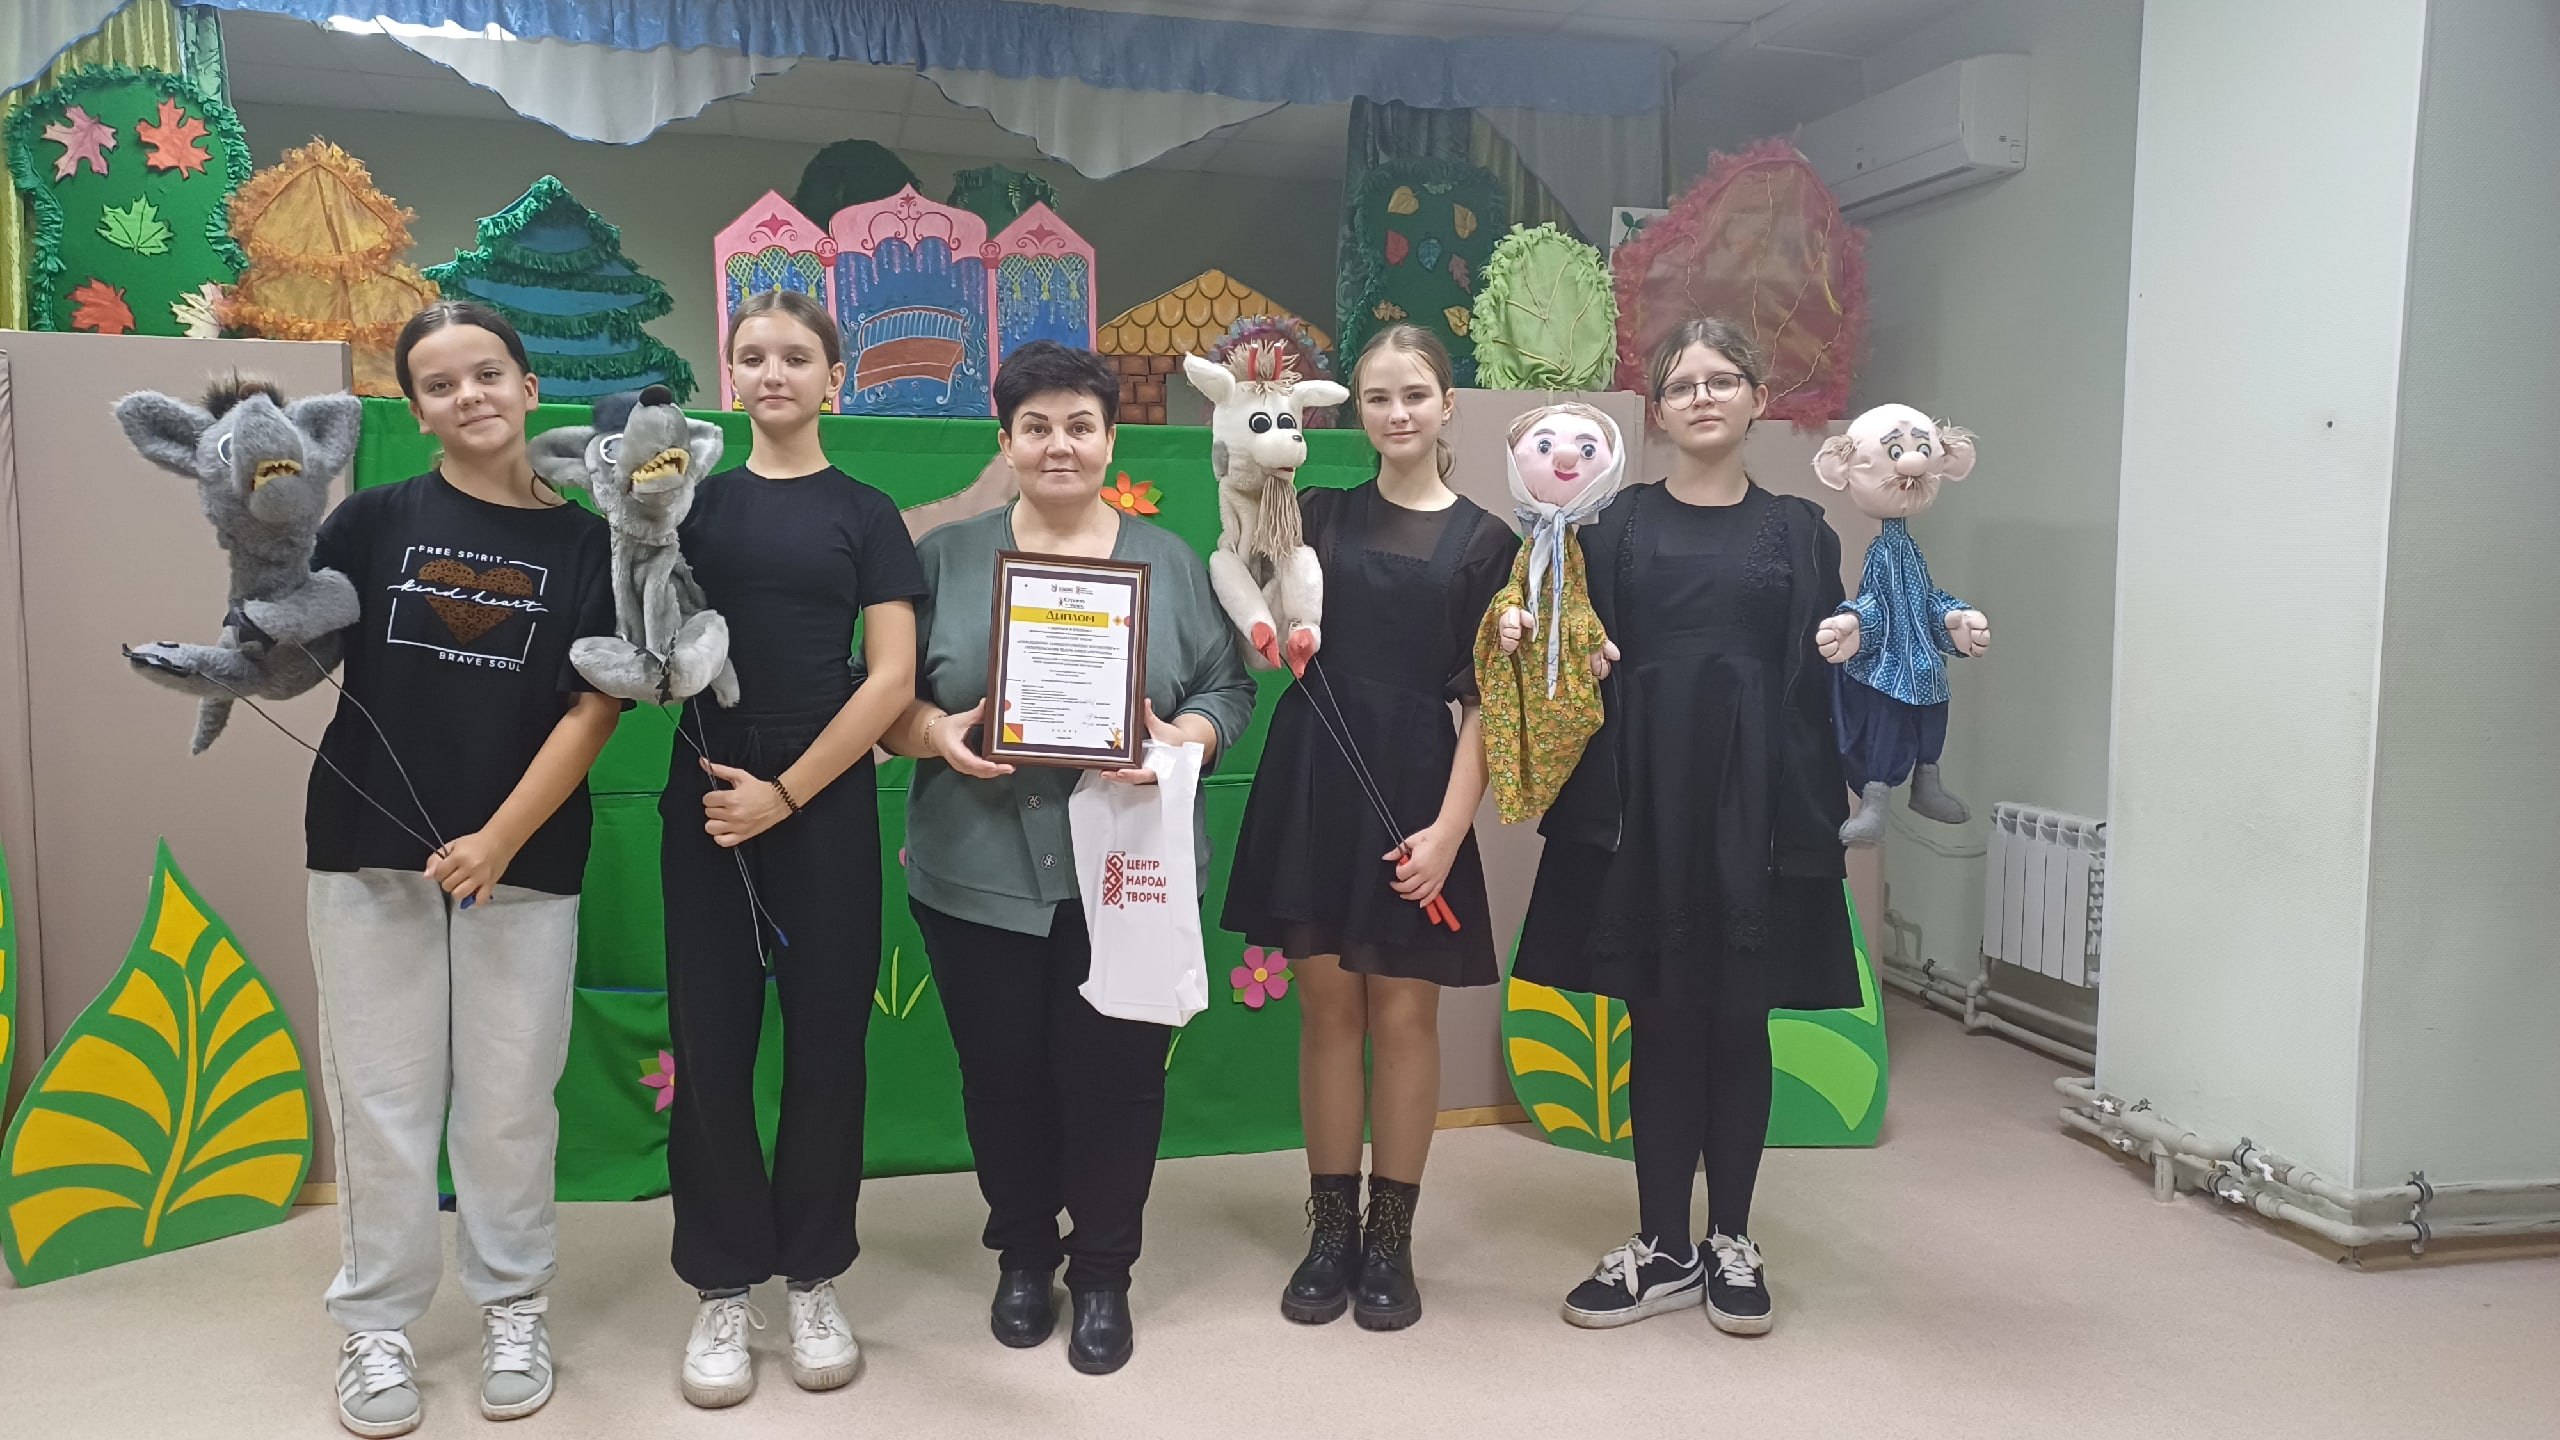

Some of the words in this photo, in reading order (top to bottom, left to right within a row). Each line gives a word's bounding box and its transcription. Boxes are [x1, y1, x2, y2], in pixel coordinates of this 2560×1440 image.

[418, 544, 451, 557] FREE
[457, 550, 508, 564] SPIRIT.
[387, 578, 468, 600] kind
[470, 590, 549, 613] heart
[438, 651, 482, 667] BRAVE
[488, 659, 521, 672] SOUL
[1126, 859, 1160, 871] ЦЕНТР
